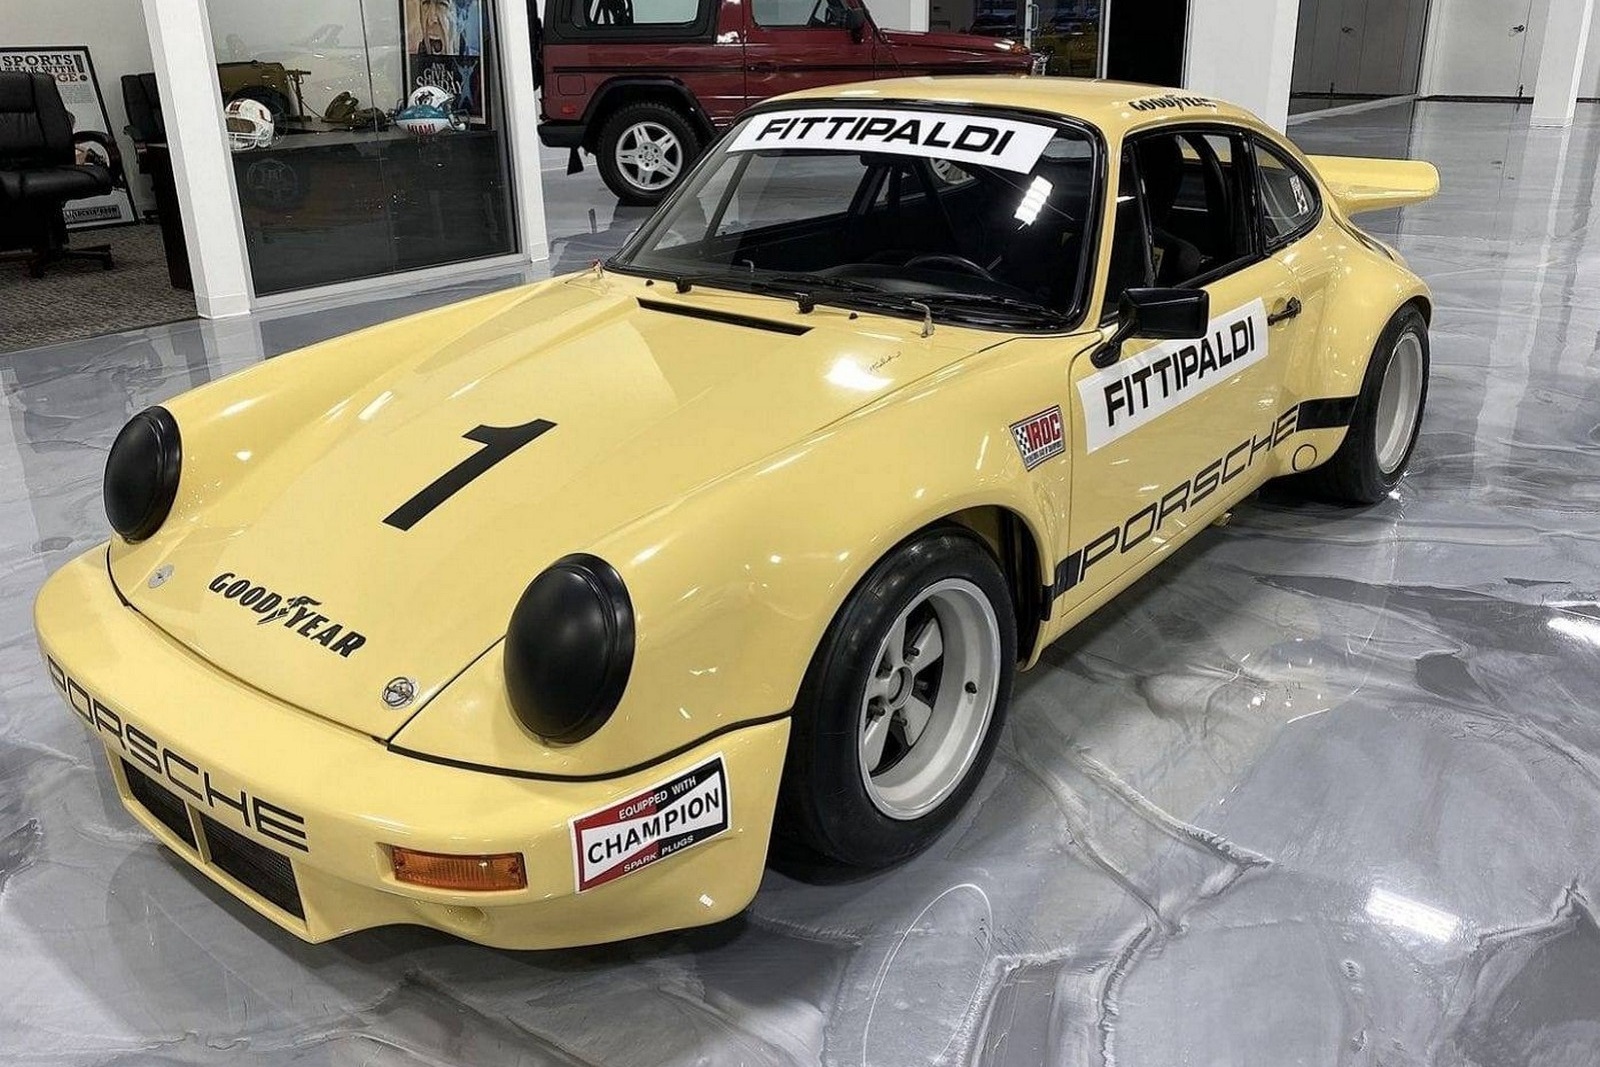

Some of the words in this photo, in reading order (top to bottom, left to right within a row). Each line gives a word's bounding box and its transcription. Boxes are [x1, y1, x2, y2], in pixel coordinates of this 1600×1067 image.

[2, 54, 73, 67] SPORTS
[423, 68, 454, 81] GIVEN
[416, 75, 463, 94] SUNDAY
[407, 124, 436, 134] MIAMI
[755, 116, 1016, 156] FITTIPALDI
[1103, 315, 1256, 427] FITTIPALDI
[1025, 412, 1061, 452] IROC
[382, 418, 558, 532] 1
[1079, 402, 1300, 582] PORSCHE
[208, 572, 367, 659] GOODYEAR
[46, 653, 309, 853] PORSCHE
[618, 789, 668, 821] EQUIPPED
[671, 775, 697, 796] WITH
[587, 787, 720, 864] CHAMPION
[623, 851, 658, 873] SPARK
[661, 834, 695, 856] PLUGS
